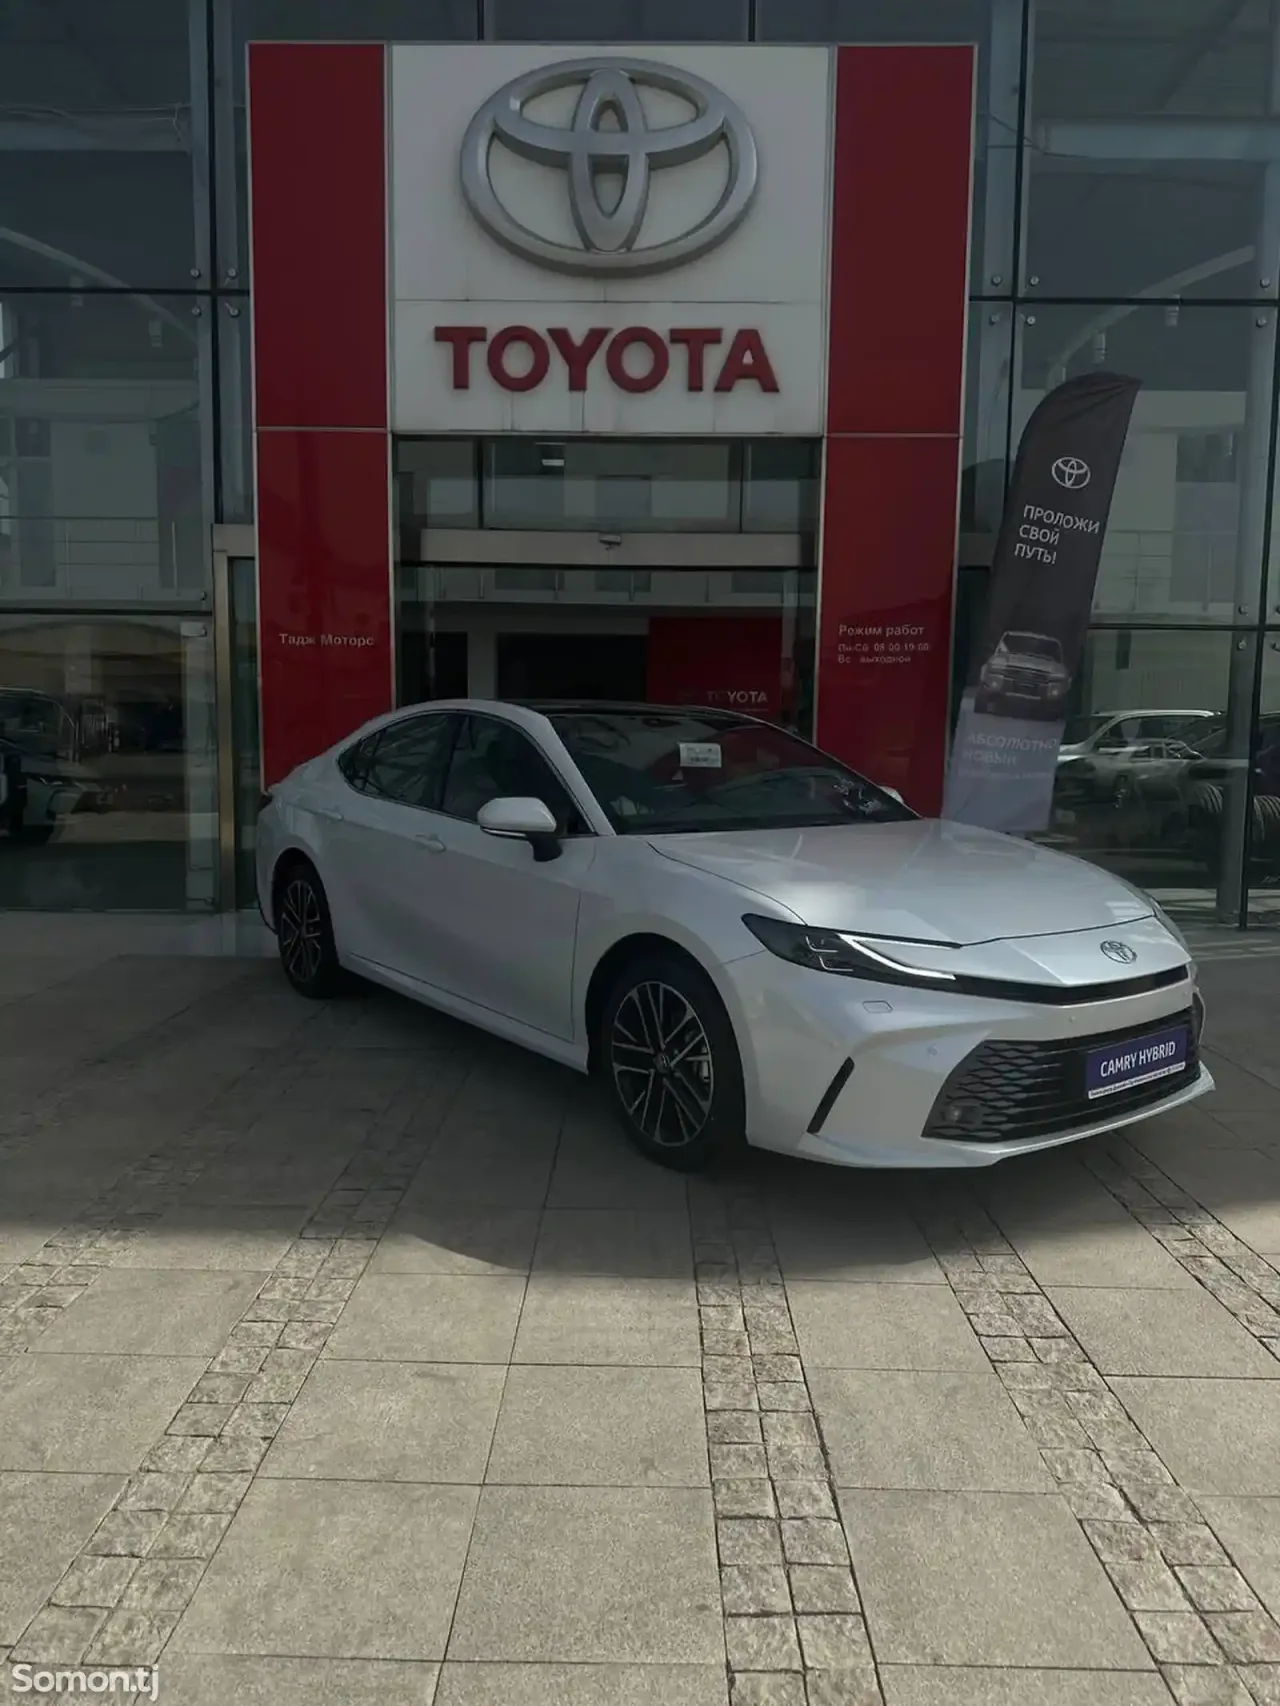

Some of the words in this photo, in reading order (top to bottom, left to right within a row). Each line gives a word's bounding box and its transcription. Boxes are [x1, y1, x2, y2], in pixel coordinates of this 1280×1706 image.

[434, 325, 780, 393] TOYOTA
[1023, 504, 1101, 534] ПРОЛОЖИ
[1019, 524, 1060, 545] СВОЙ
[1014, 543, 1057, 564] ПУТЬ!
[320, 634, 374, 648] Моторс
[1100, 1052, 1137, 1077] CAMRY
[1138, 1041, 1176, 1066] HYBRID
